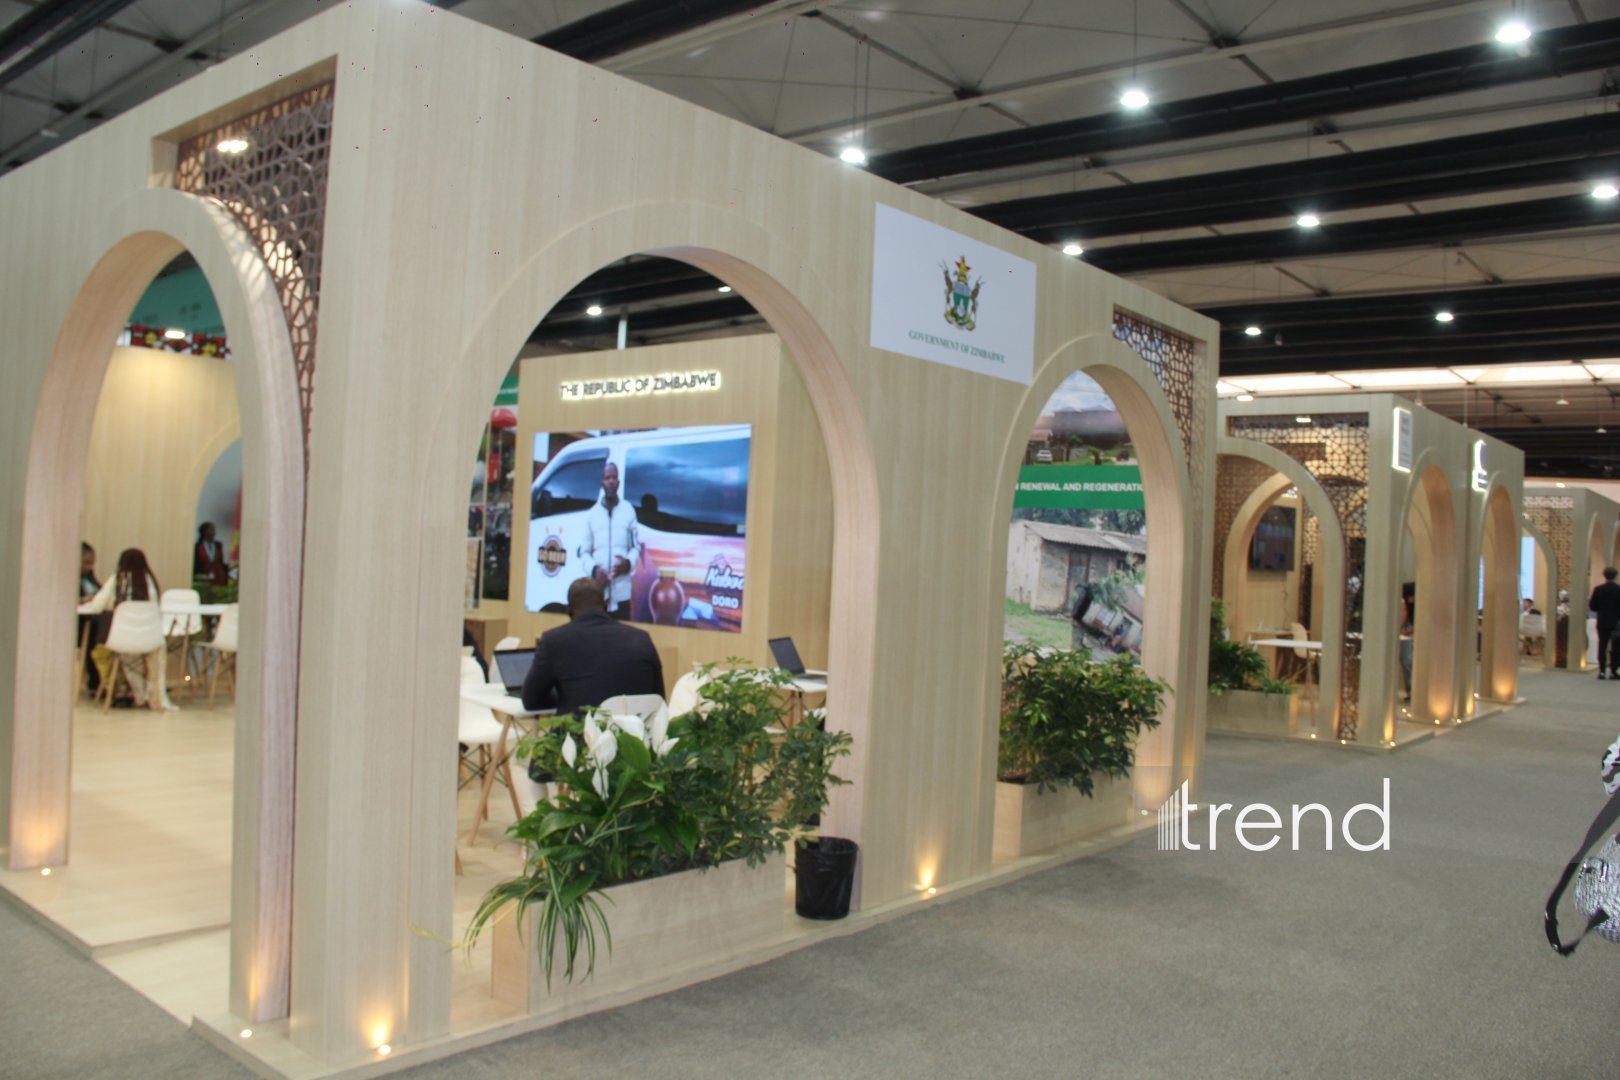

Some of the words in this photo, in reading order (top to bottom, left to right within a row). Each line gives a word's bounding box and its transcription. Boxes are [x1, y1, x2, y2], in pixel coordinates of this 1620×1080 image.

[908, 329, 960, 351] GOVERNMENT
[960, 343, 970, 354] OF
[970, 346, 1006, 364] ZIMBABWE
[560, 384, 579, 397] THE
[583, 379, 632, 395] REPUBLIC
[634, 377, 650, 392] OF
[653, 372, 718, 391] ZIMBABWE
[1020, 482, 1061, 491] RENEWAL
[1063, 482, 1082, 491] AND
[712, 594, 740, 609] DORO
